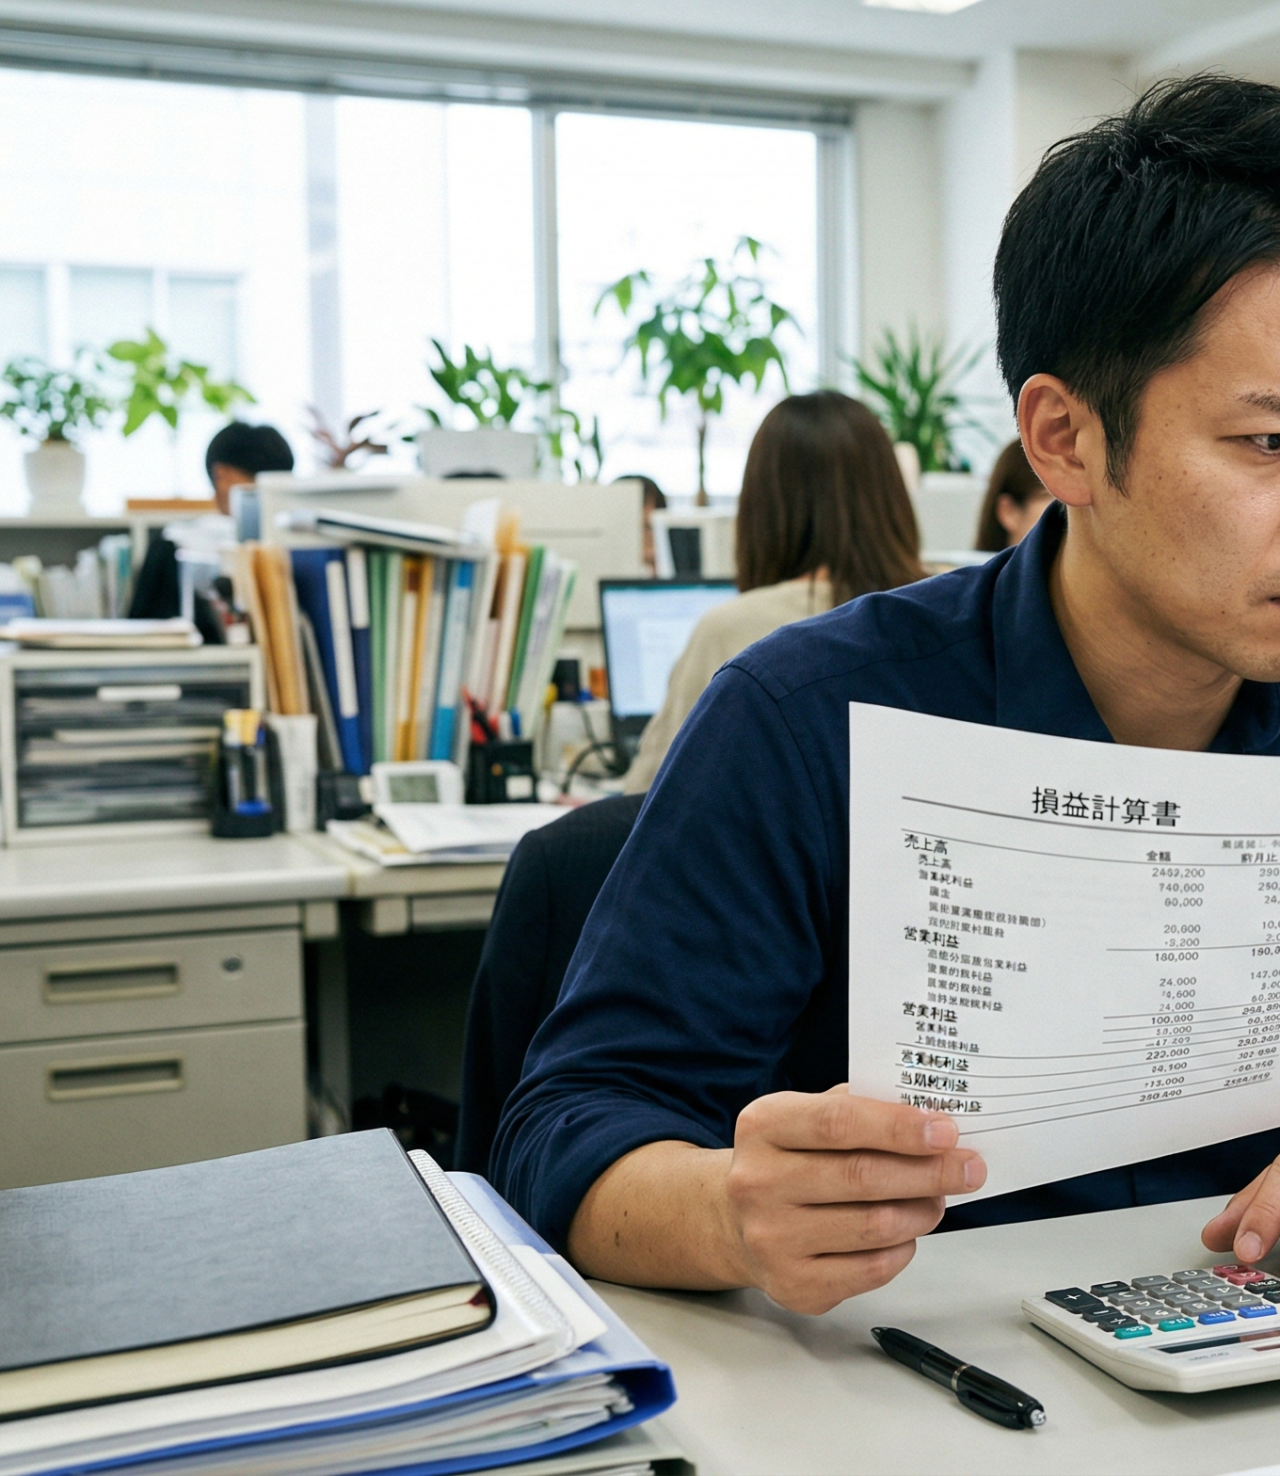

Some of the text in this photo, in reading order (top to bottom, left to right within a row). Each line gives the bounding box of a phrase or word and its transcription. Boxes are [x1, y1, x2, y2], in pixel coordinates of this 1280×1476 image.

[1031, 785, 1181, 828] 損益計算書
